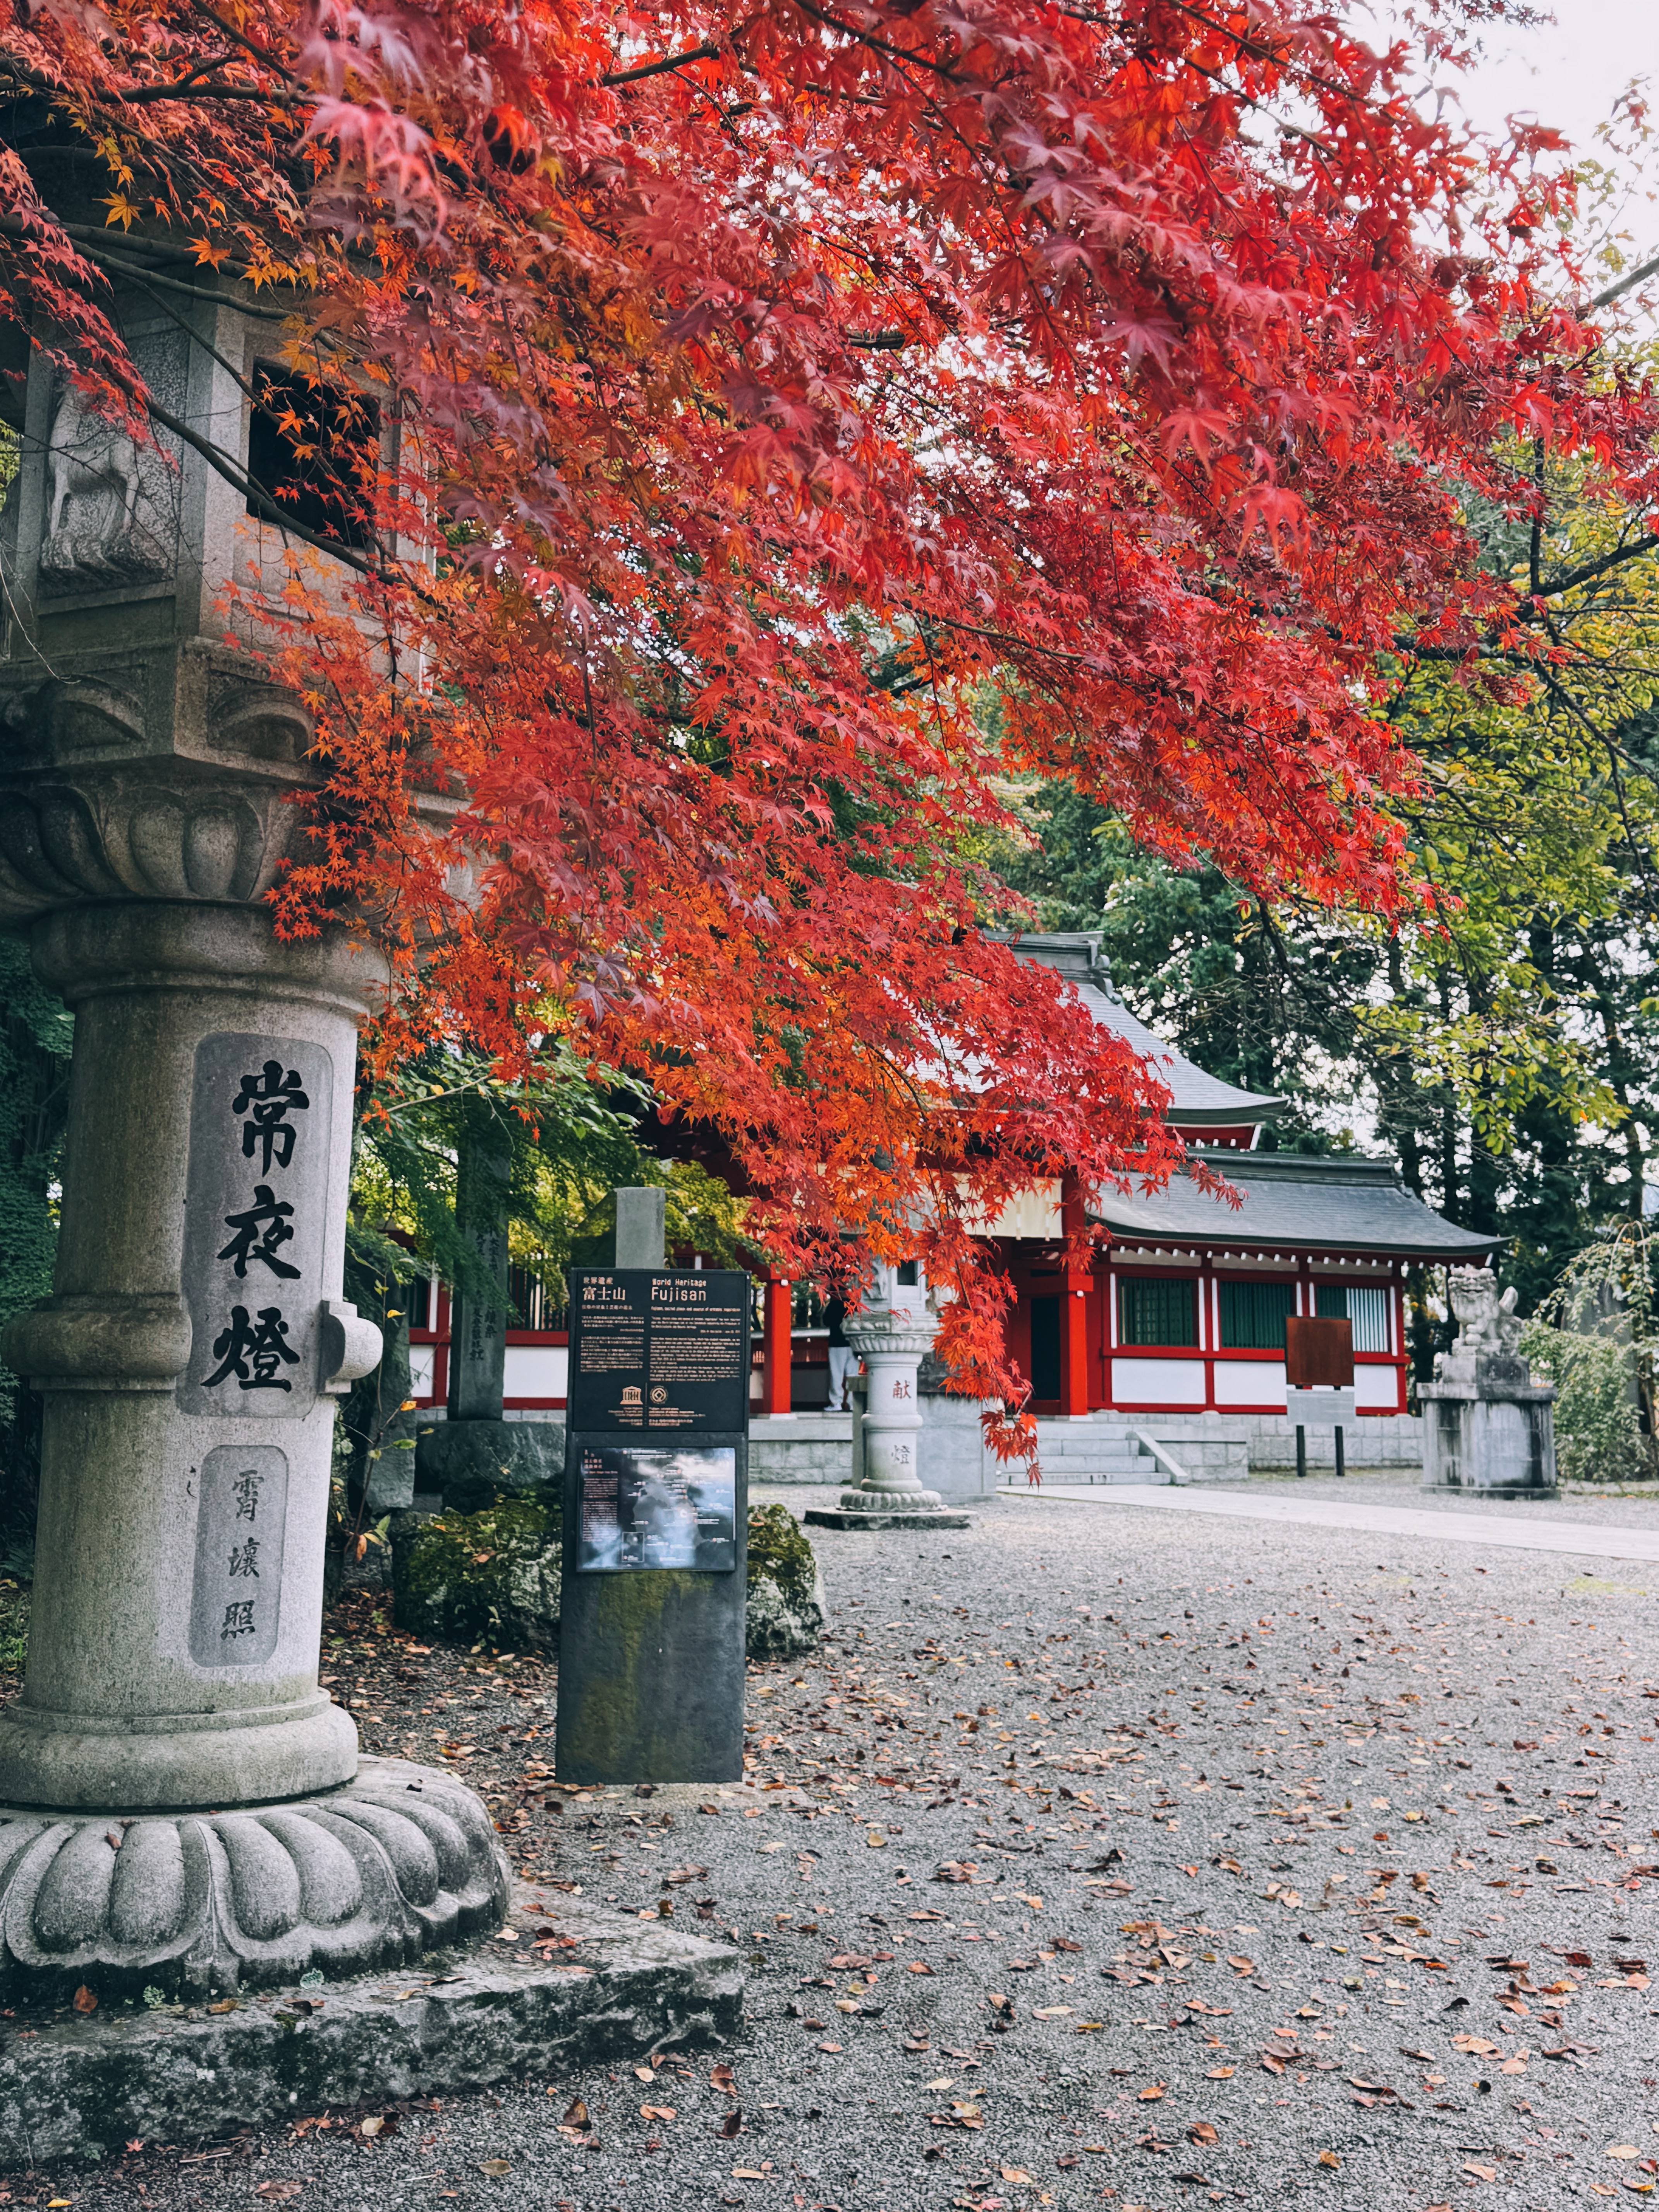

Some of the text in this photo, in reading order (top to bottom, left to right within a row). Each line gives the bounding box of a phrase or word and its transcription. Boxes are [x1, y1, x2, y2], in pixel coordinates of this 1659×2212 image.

[200, 1060, 310, 1393] 常夜燈
[675, 1278, 707, 1287] Heritage
[582, 1286, 625, 1301] 富士山
[651, 1286, 706, 1302] Fujisan
[891, 1380, 911, 1464] 献燈
